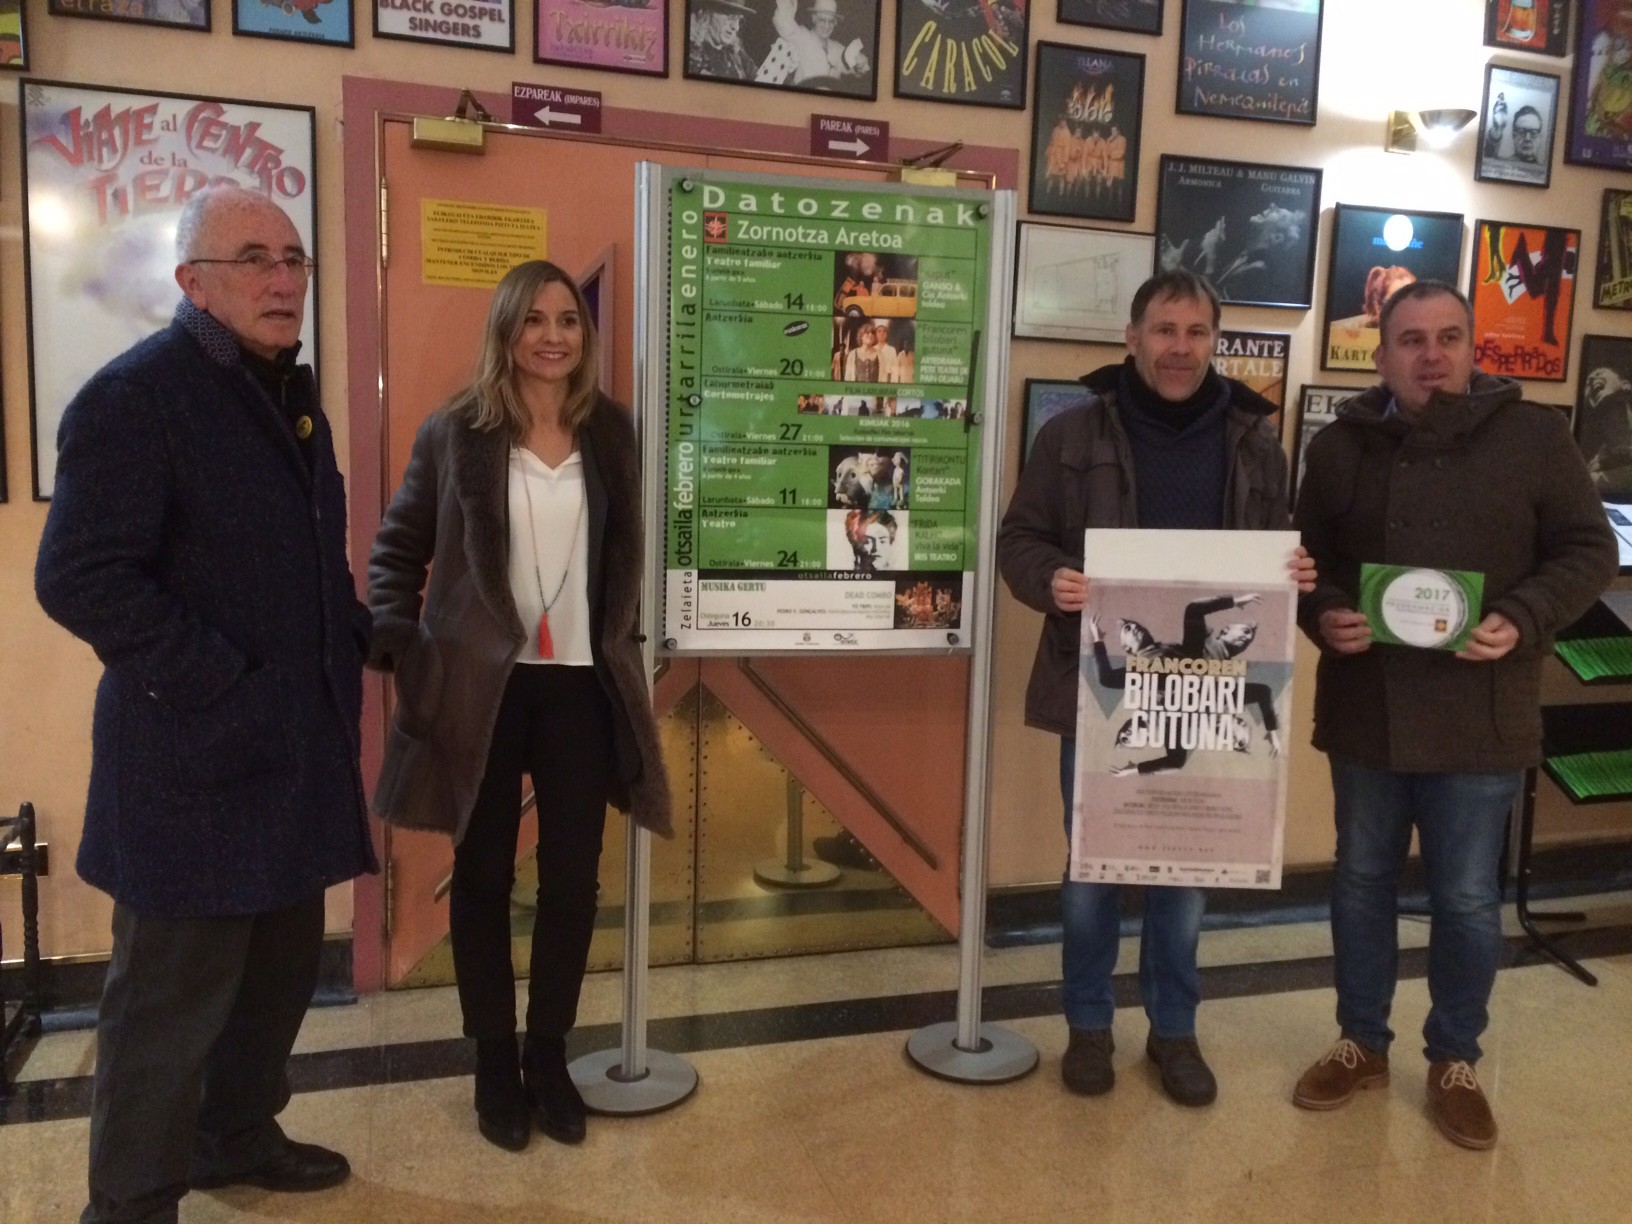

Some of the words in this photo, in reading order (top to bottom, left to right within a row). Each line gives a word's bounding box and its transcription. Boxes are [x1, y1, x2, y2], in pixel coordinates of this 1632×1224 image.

[379, 0, 434, 14] BLACK
[439, 2, 505, 24] GOSPEL
[408, 16, 482, 39] SINGERS
[902, 20, 1019, 93] CARACOL
[513, 85, 563, 103] EZPAREAK
[563, 93, 600, 109] (IMPARES)
[819, 119, 853, 133] PAREAK
[854, 124, 880, 136] (PARES)
[139, 150, 165, 166] de
[171, 151, 188, 168] la
[160, 113, 178, 132] al
[185, 101, 306, 199] CENTRO
[1167, 161, 1178, 173] J.
[1188, 164, 1235, 178] MILTEAU
[1236, 170, 1245, 178] &
[1247, 169, 1278, 182] MANU
[1280, 172, 1317, 185] GALVIN
[701, 184, 975, 227] Datozenak
[736, 219, 829, 245] Zornotza
[834, 226, 904, 249] Aretoa
[706, 257, 741, 267] Teatro
[744, 258, 782, 269] familiar
[1601, 280, 1632, 302] METR
[784, 293, 804, 310] 14
[705, 312, 753, 323] Antzerkia
[1215, 337, 1285, 358] RANTE
[779, 358, 804, 376] 20
[1211, 356, 1283, 377] RTALE
[703, 389, 775, 402] Cortometrajes
[1306, 393, 1346, 416] EK
[779, 423, 803, 441] 27
[702, 455, 737, 465] Teatro
[739, 456, 778, 466] familiar
[779, 488, 797, 505] 11
[701, 509, 749, 519] Antzerkia
[701, 519, 737, 528] Teatro
[777, 550, 799, 568] 24
[929, 553, 958, 562] TEATRO
[701, 581, 736, 592] MUSIKA
[737, 581, 767, 592] GERTU
[844, 591, 866, 600] DEAD
[866, 591, 892, 600] COMBO
[1414, 587, 1451, 601] 2017
[680, 571, 693, 630] Zelaieta
[707, 620, 730, 628] Jueves
[731, 611, 752, 627] 16
[1125, 655, 1248, 676] FRANCOREN
[1123, 672, 1246, 714] BILOBARI
